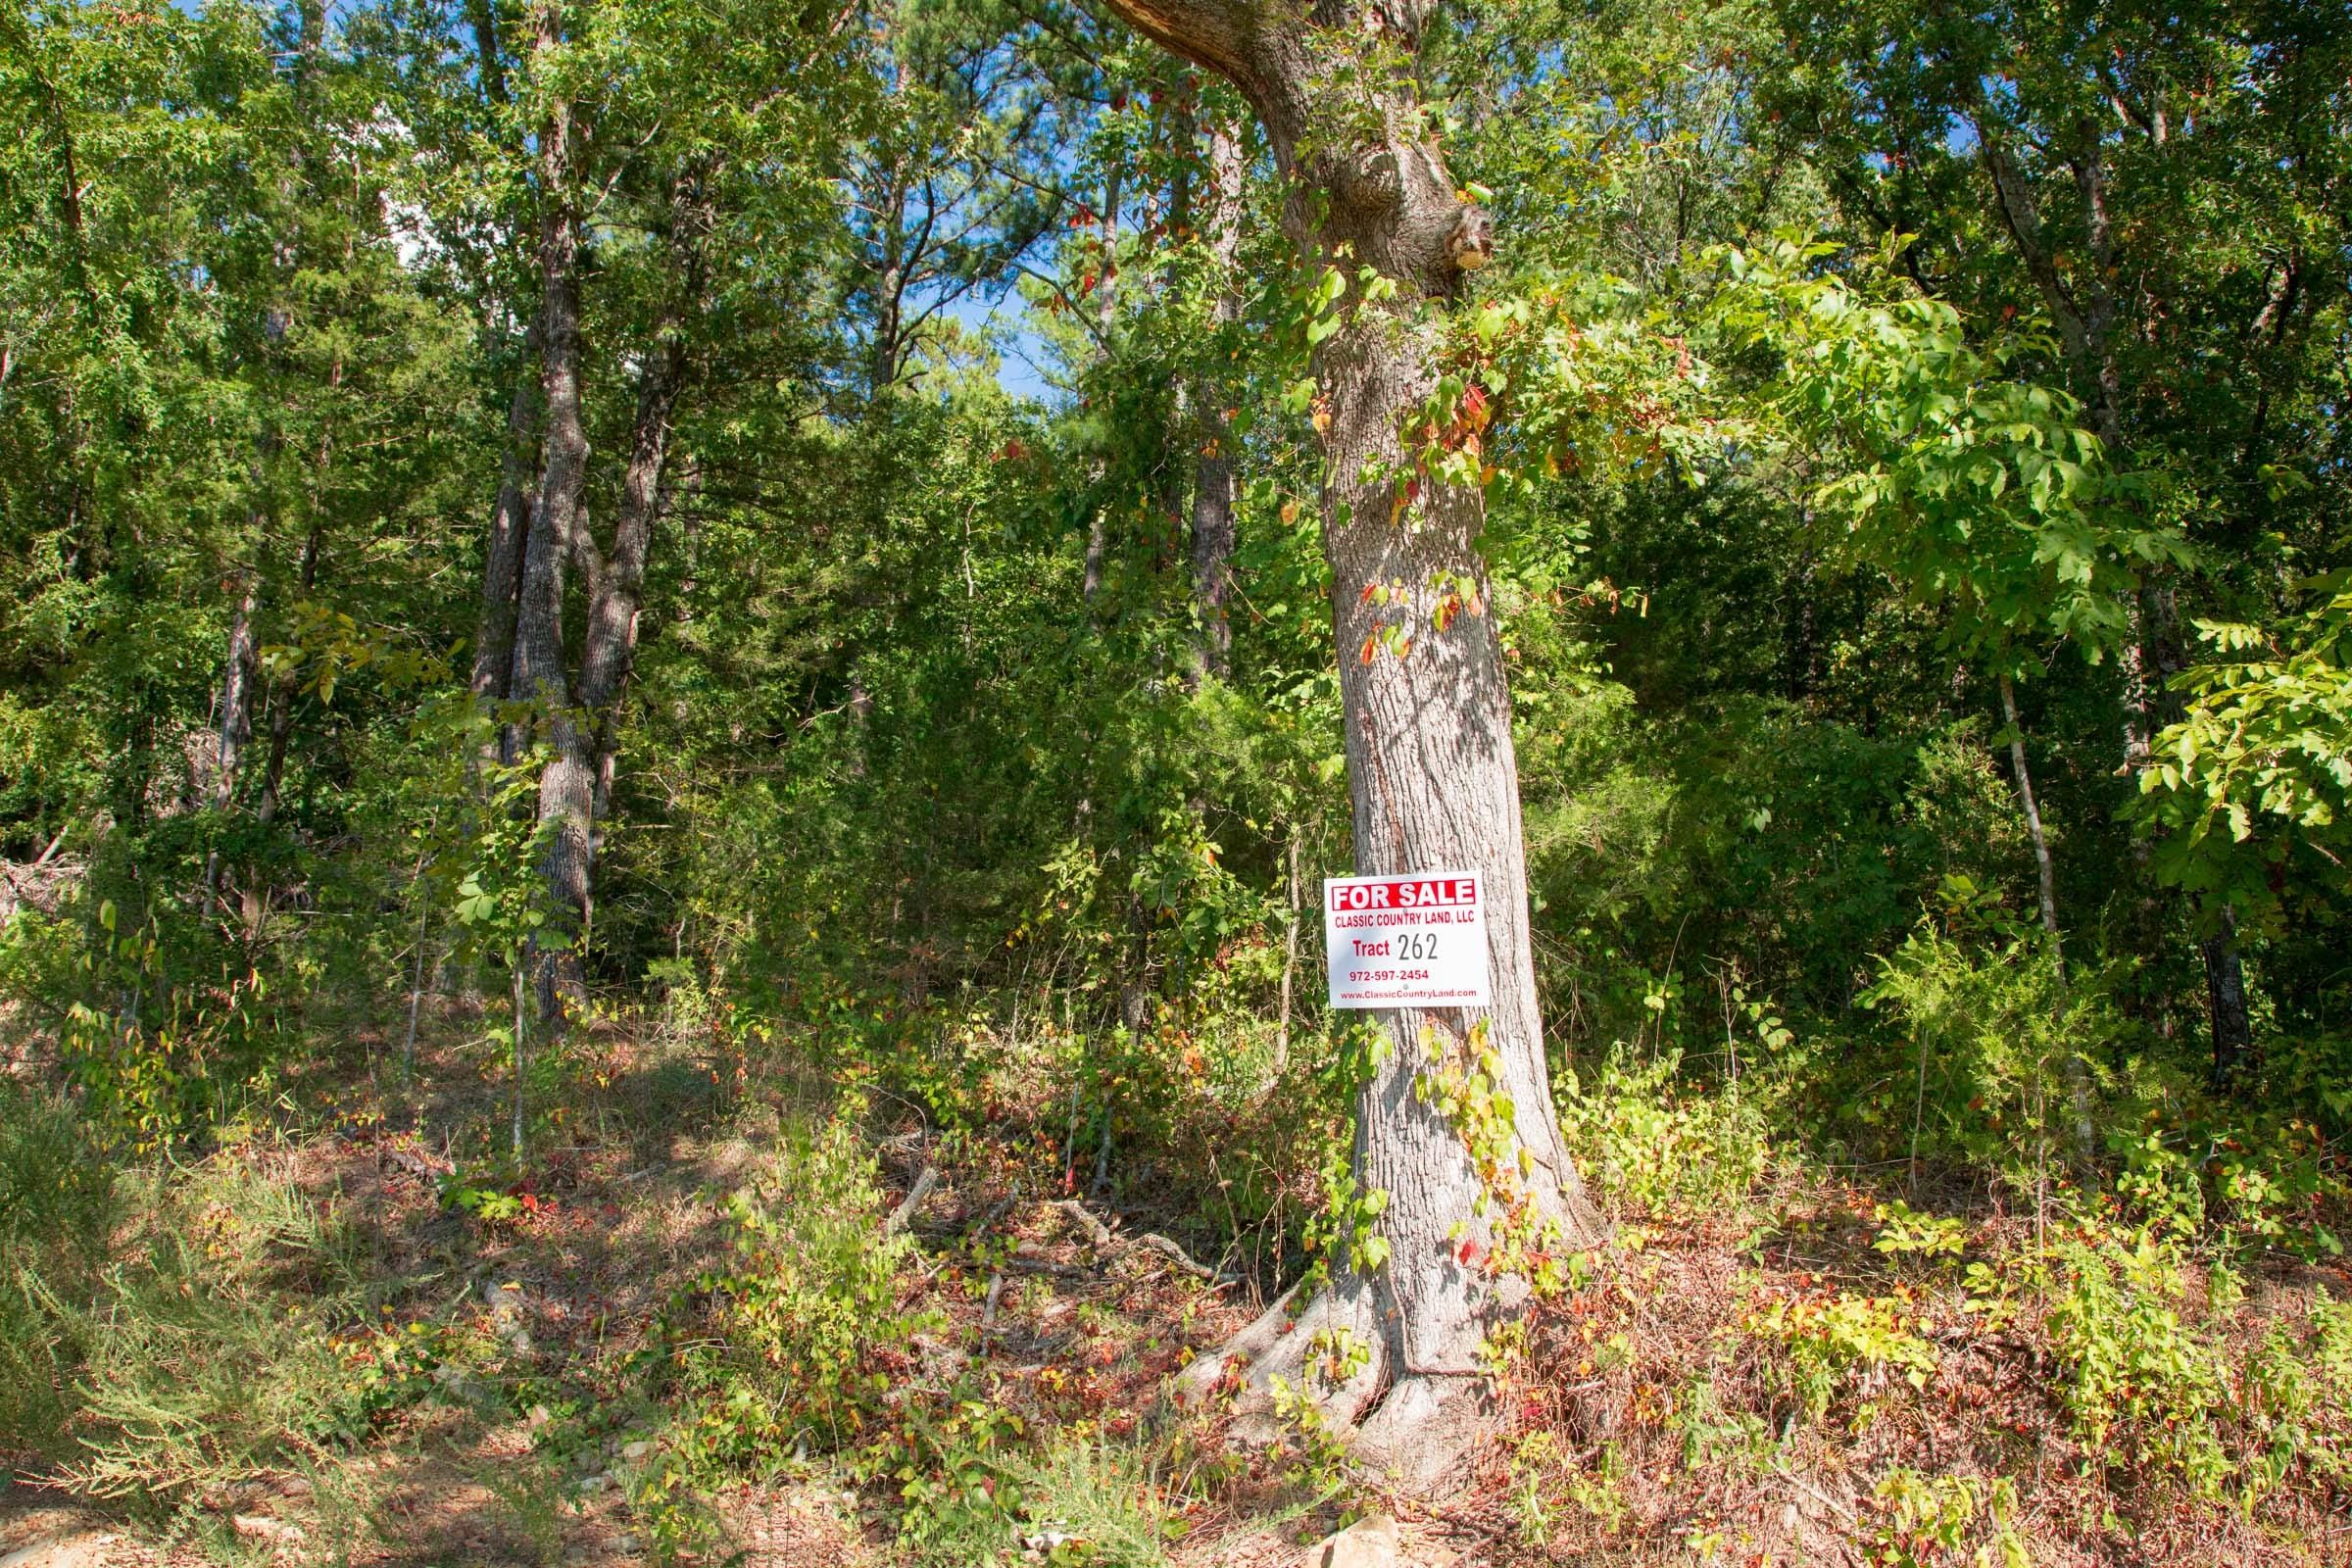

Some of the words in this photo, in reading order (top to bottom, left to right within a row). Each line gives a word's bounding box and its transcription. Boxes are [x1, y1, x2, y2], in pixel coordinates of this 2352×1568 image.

[1333, 885, 1390, 910] FOR
[1398, 880, 1475, 906] SALE
[1335, 914, 1374, 928] CLASSIC
[1377, 912, 1421, 926] COUNTRY
[1425, 911, 1454, 925] LAND,
[1456, 910, 1475, 923] LLC
[1352, 939, 1390, 956] Tract
[1397, 933, 1438, 960] 262
[1349, 969, 1429, 982] 972-597-2454
[1341, 989, 1477, 1000] www.ClassicCountryLand.com
